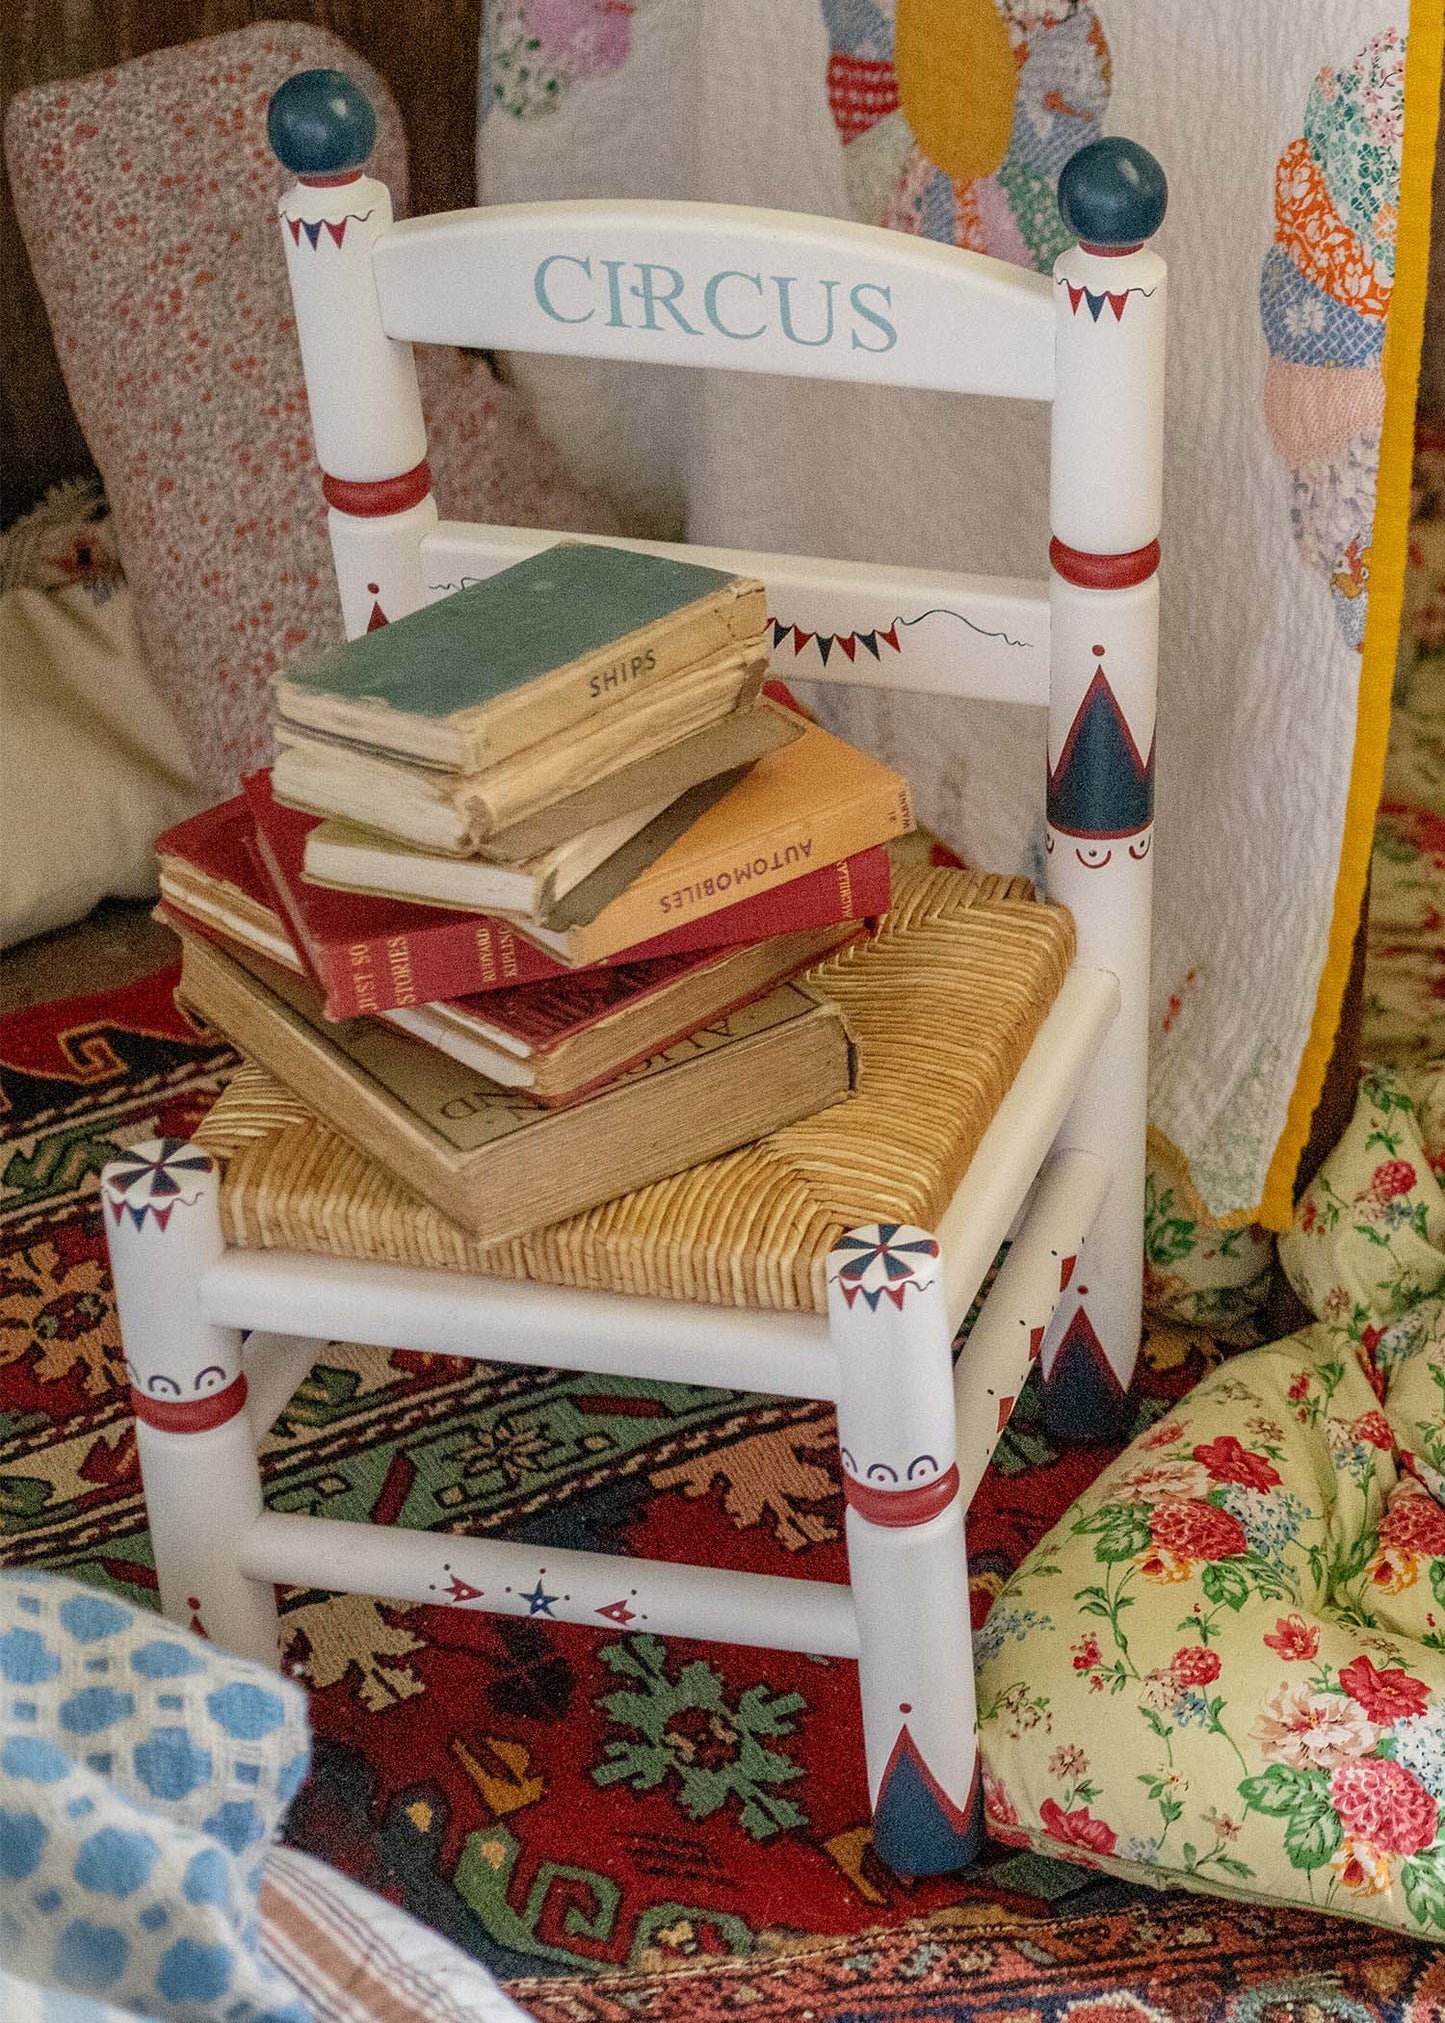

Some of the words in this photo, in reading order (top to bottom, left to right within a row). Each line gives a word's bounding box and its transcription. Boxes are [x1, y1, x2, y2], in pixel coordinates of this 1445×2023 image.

[534, 254, 898, 353] CIRCUS
[589, 648, 656, 698] SHIPS
[660, 838, 813, 914] AUTOMOBILES
[350, 944, 371, 967] SO
[388, 936, 416, 1006] STORIES
[478, 928, 496, 982] RUDYARD
[499, 927, 518, 977] KIPLIN
[354, 972, 378, 1010] JUST
